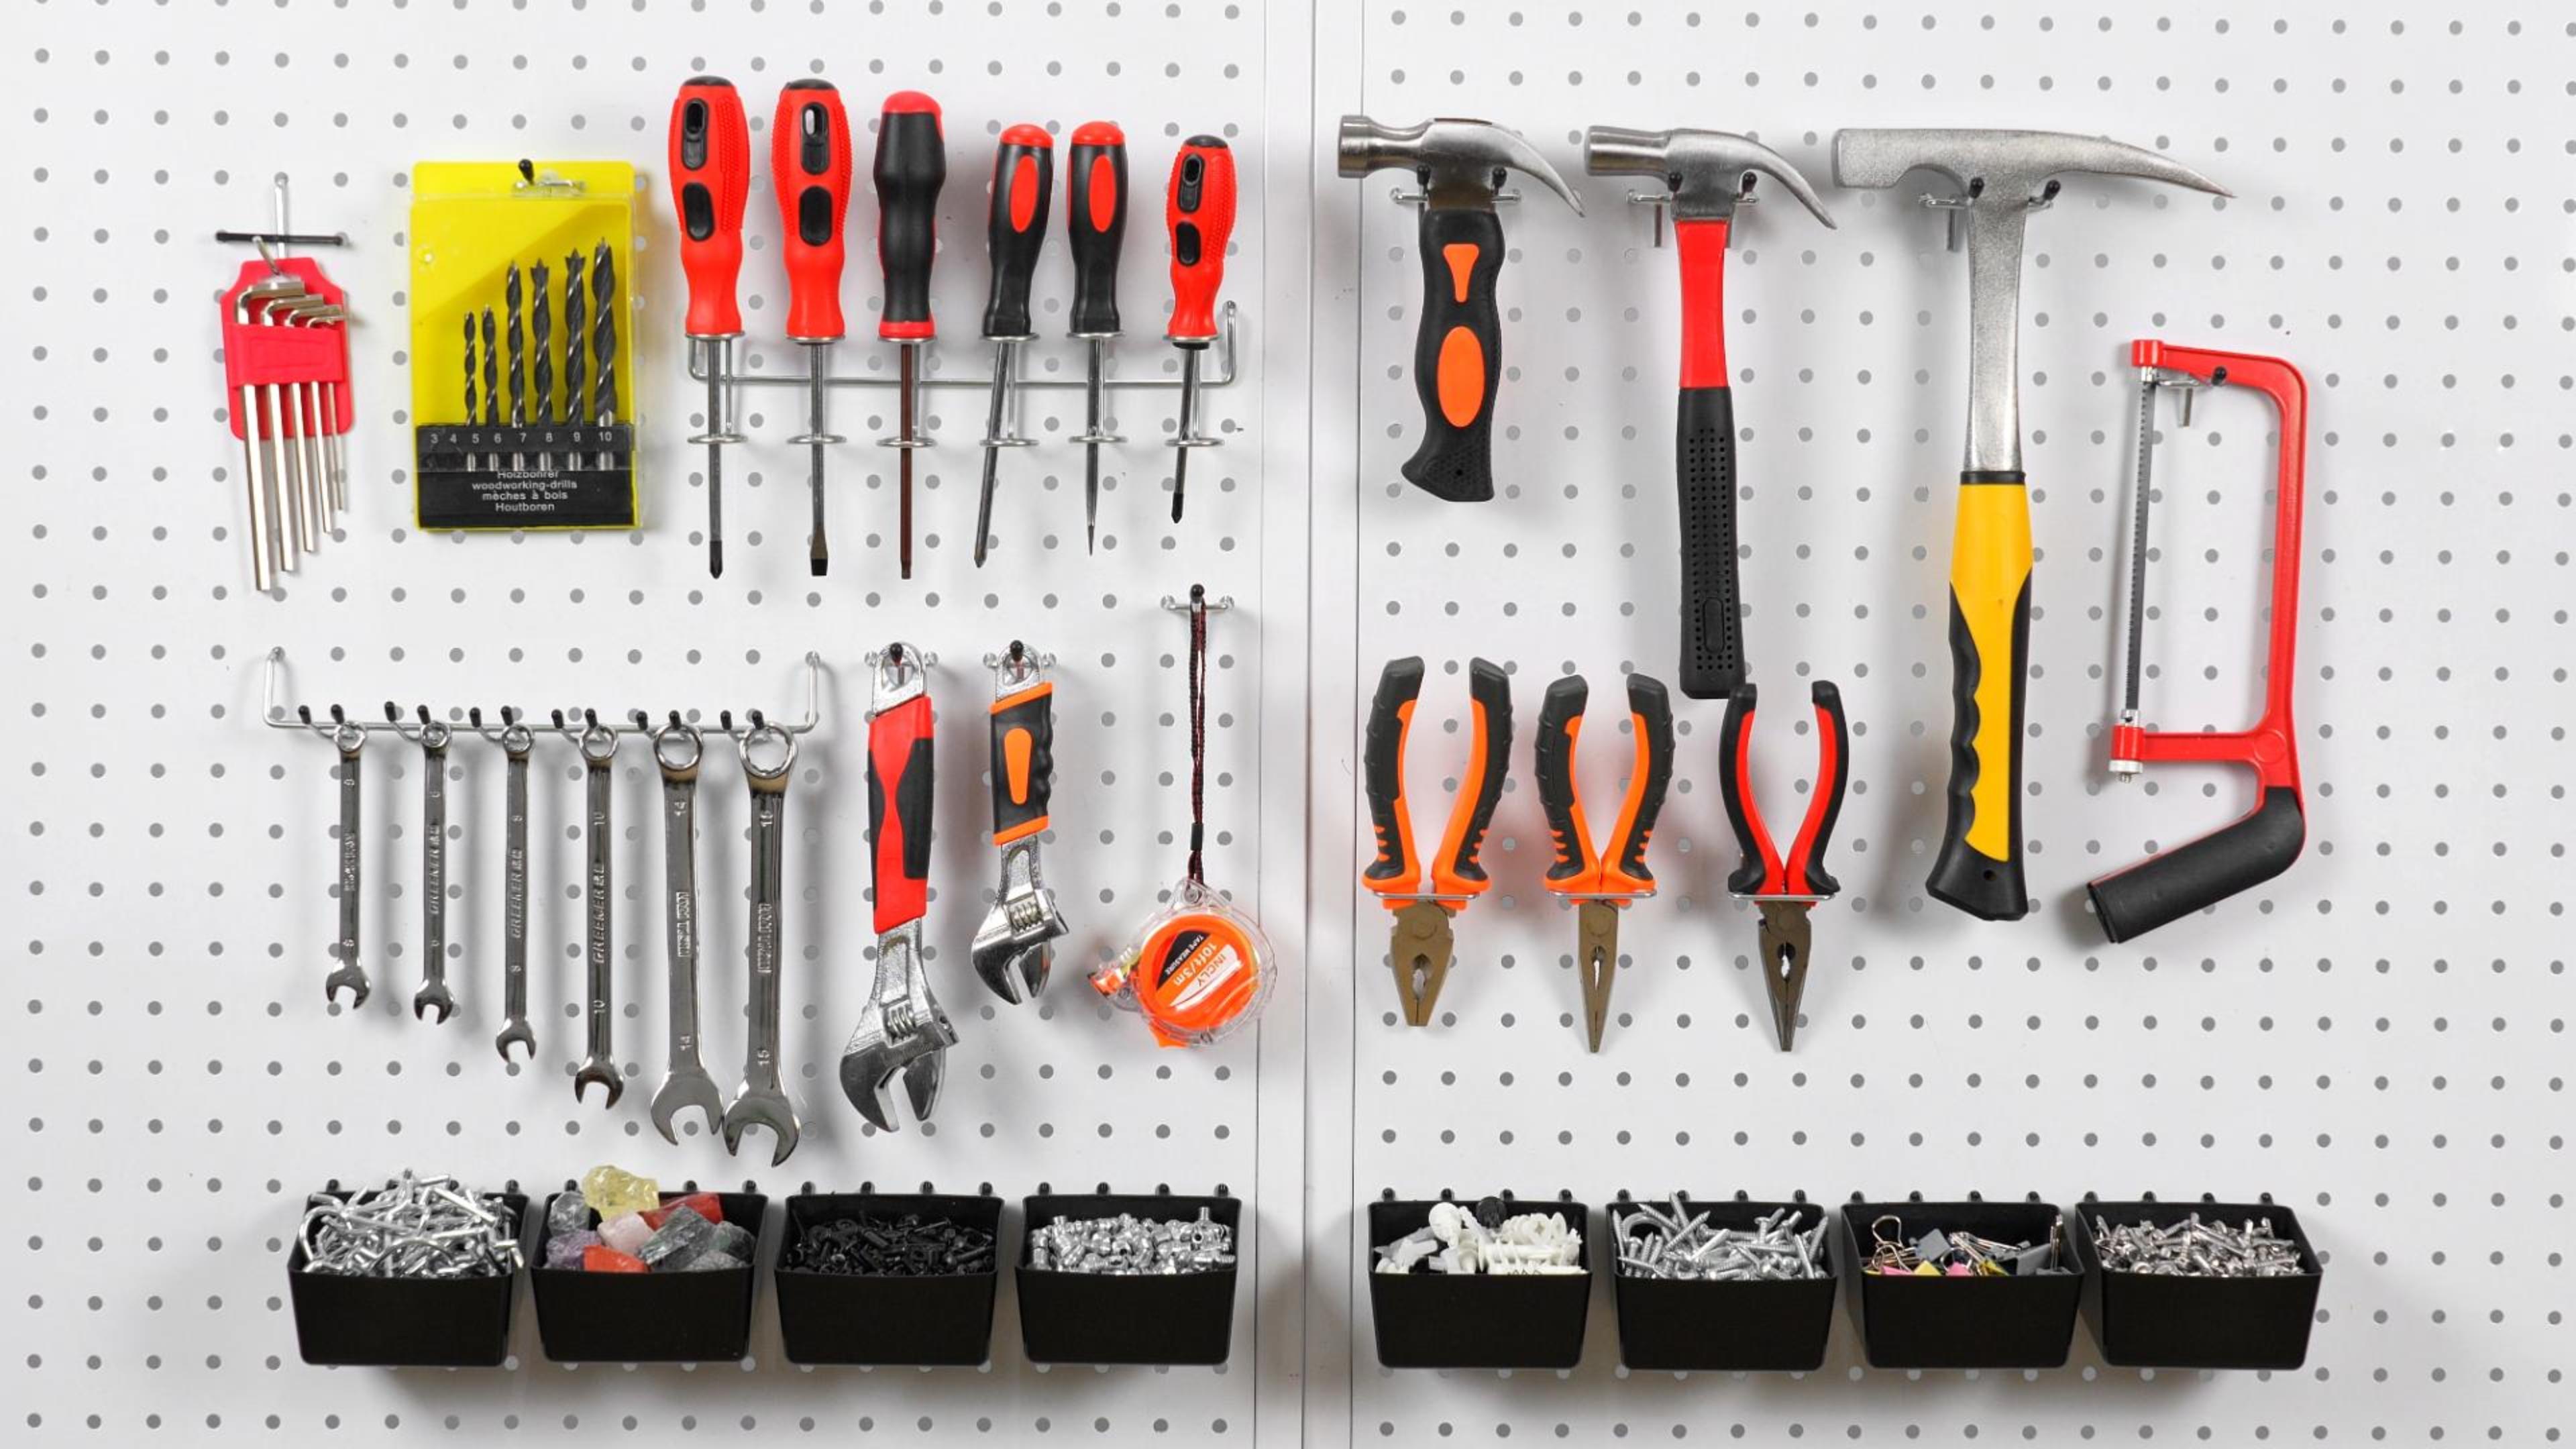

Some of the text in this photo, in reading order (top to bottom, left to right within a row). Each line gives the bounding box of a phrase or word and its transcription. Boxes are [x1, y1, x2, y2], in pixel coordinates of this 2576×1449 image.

[431, 431, 612, 444] 3 4 5 6 7 8 9 10
[472, 481, 578, 491] woodworking-drills
[482, 492, 527, 500] mèches
[544, 491, 568, 500] bois
[496, 502, 555, 512] Houtboren
[1187, 934, 1204, 951] TAPE
[1173, 943, 1218, 986] 10ft/3m
